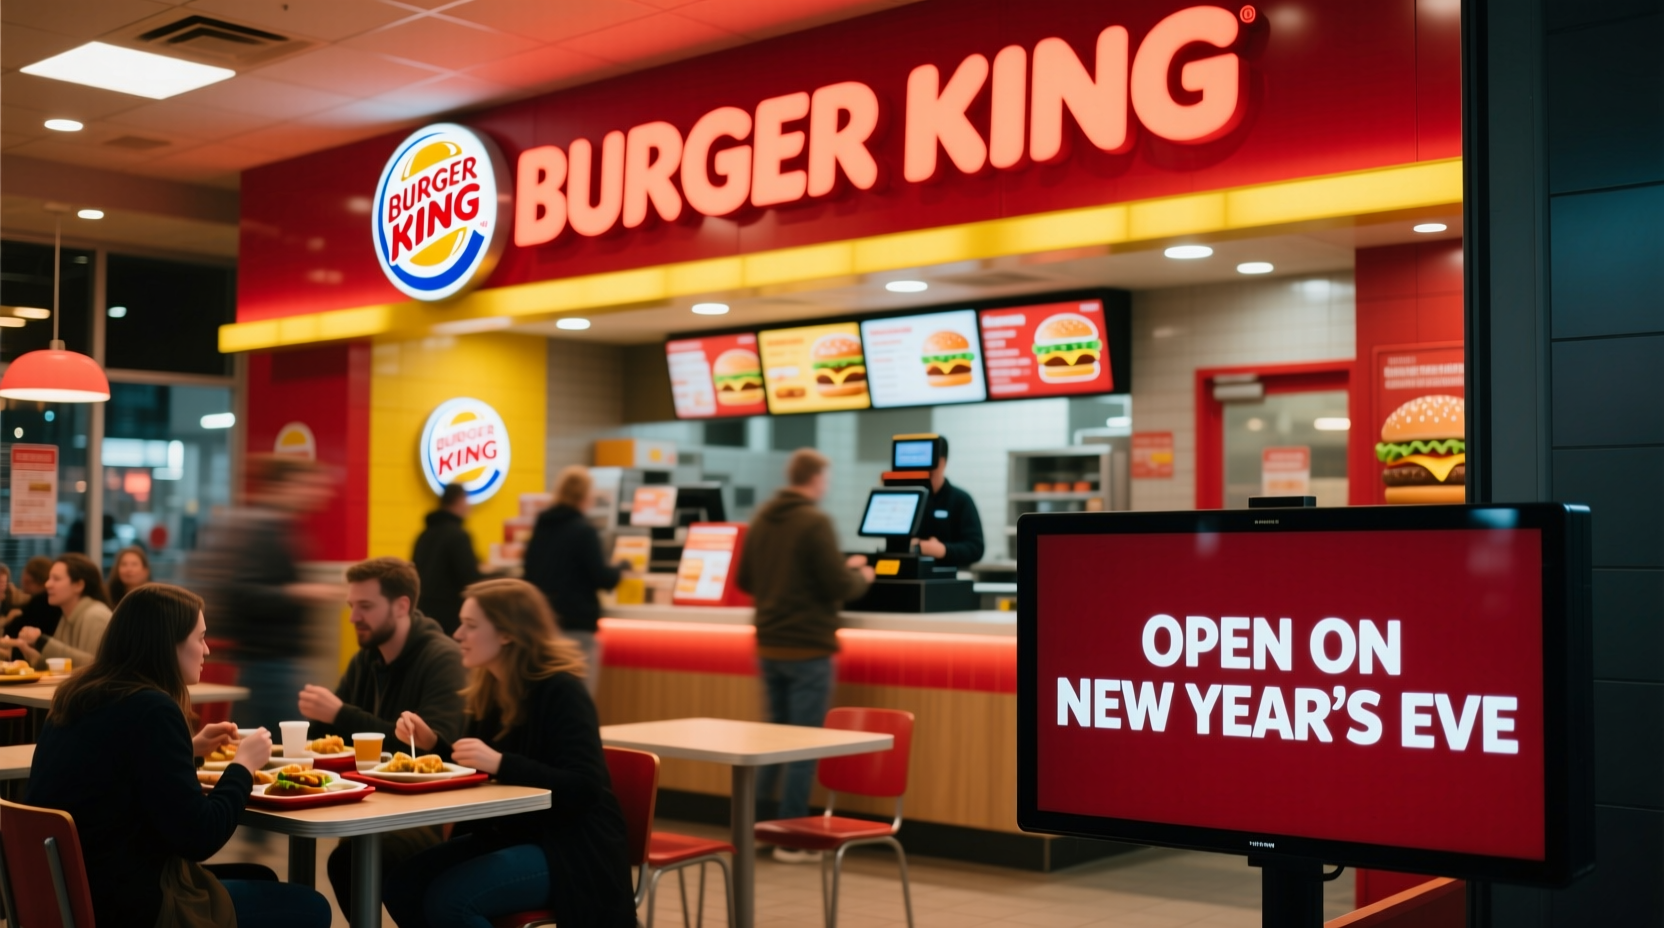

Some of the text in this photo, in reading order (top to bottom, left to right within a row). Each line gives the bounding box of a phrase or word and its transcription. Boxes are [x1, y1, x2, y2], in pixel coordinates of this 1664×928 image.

[514, 5, 1239, 248] BURGER KING
[388, 156, 478, 224] BURGER
[391, 183, 481, 262] KING
[438, 440, 498, 476] KING
[1141, 613, 1401, 676] OPEN ON
[1057, 677, 1175, 732] NEW
[1401, 692, 1519, 754] EVE
